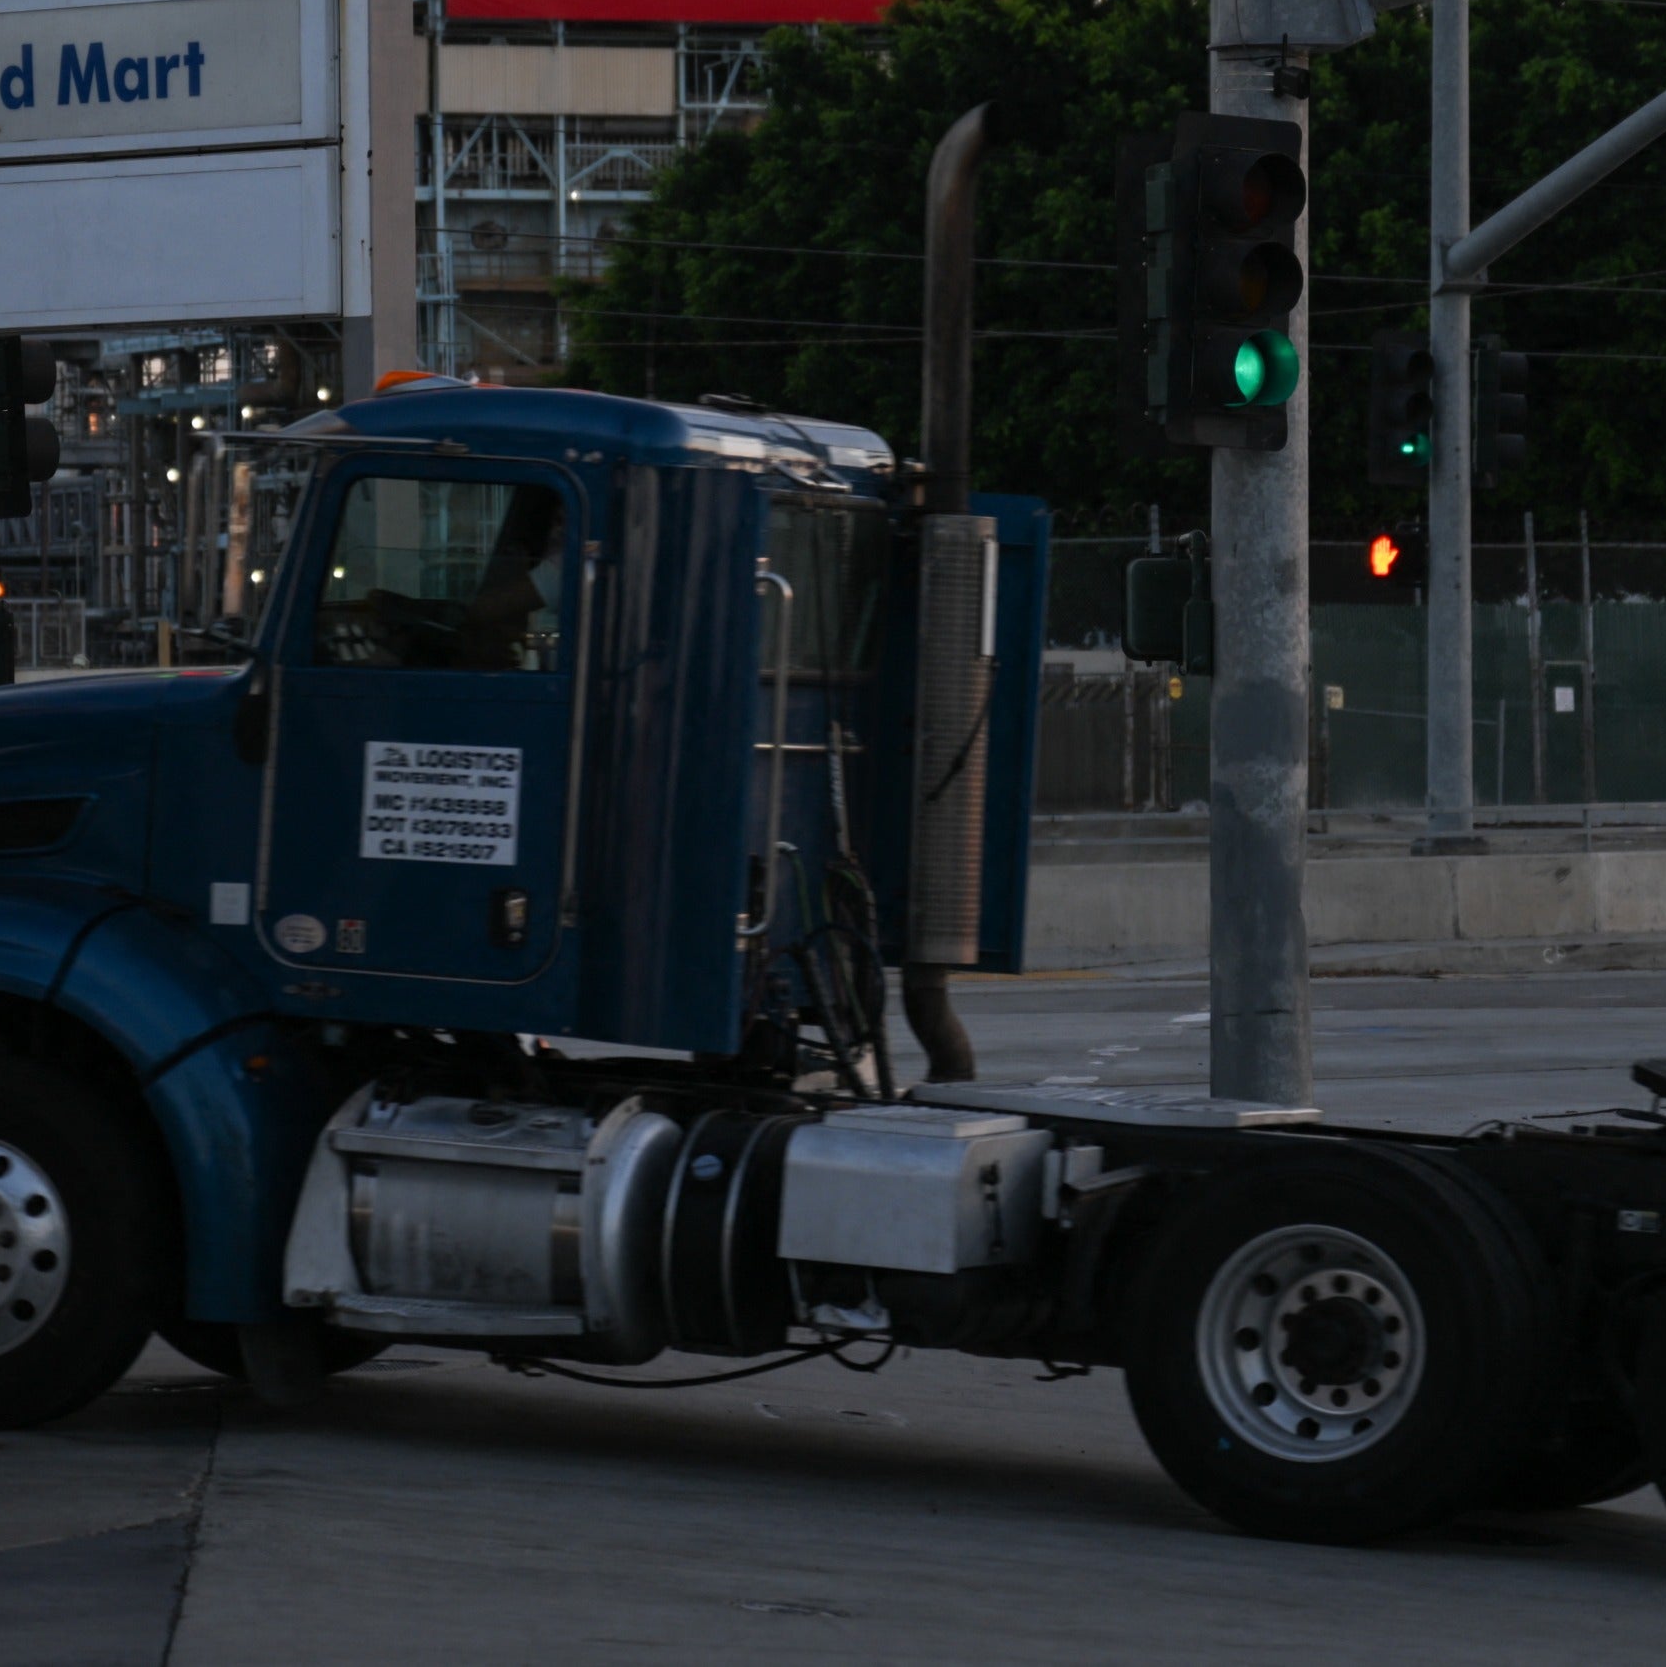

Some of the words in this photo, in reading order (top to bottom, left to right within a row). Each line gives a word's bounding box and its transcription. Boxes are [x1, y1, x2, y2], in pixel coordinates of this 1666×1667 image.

[57, 40, 205, 107] Mart
[415, 749, 517, 771] LOGISTICS
[373, 770, 474, 789] MOVEMENT,
[478, 775, 515, 789] INC.
[373, 794, 406, 811] MC
[367, 815, 407, 832] DOT
[380, 838, 408, 854] CA
